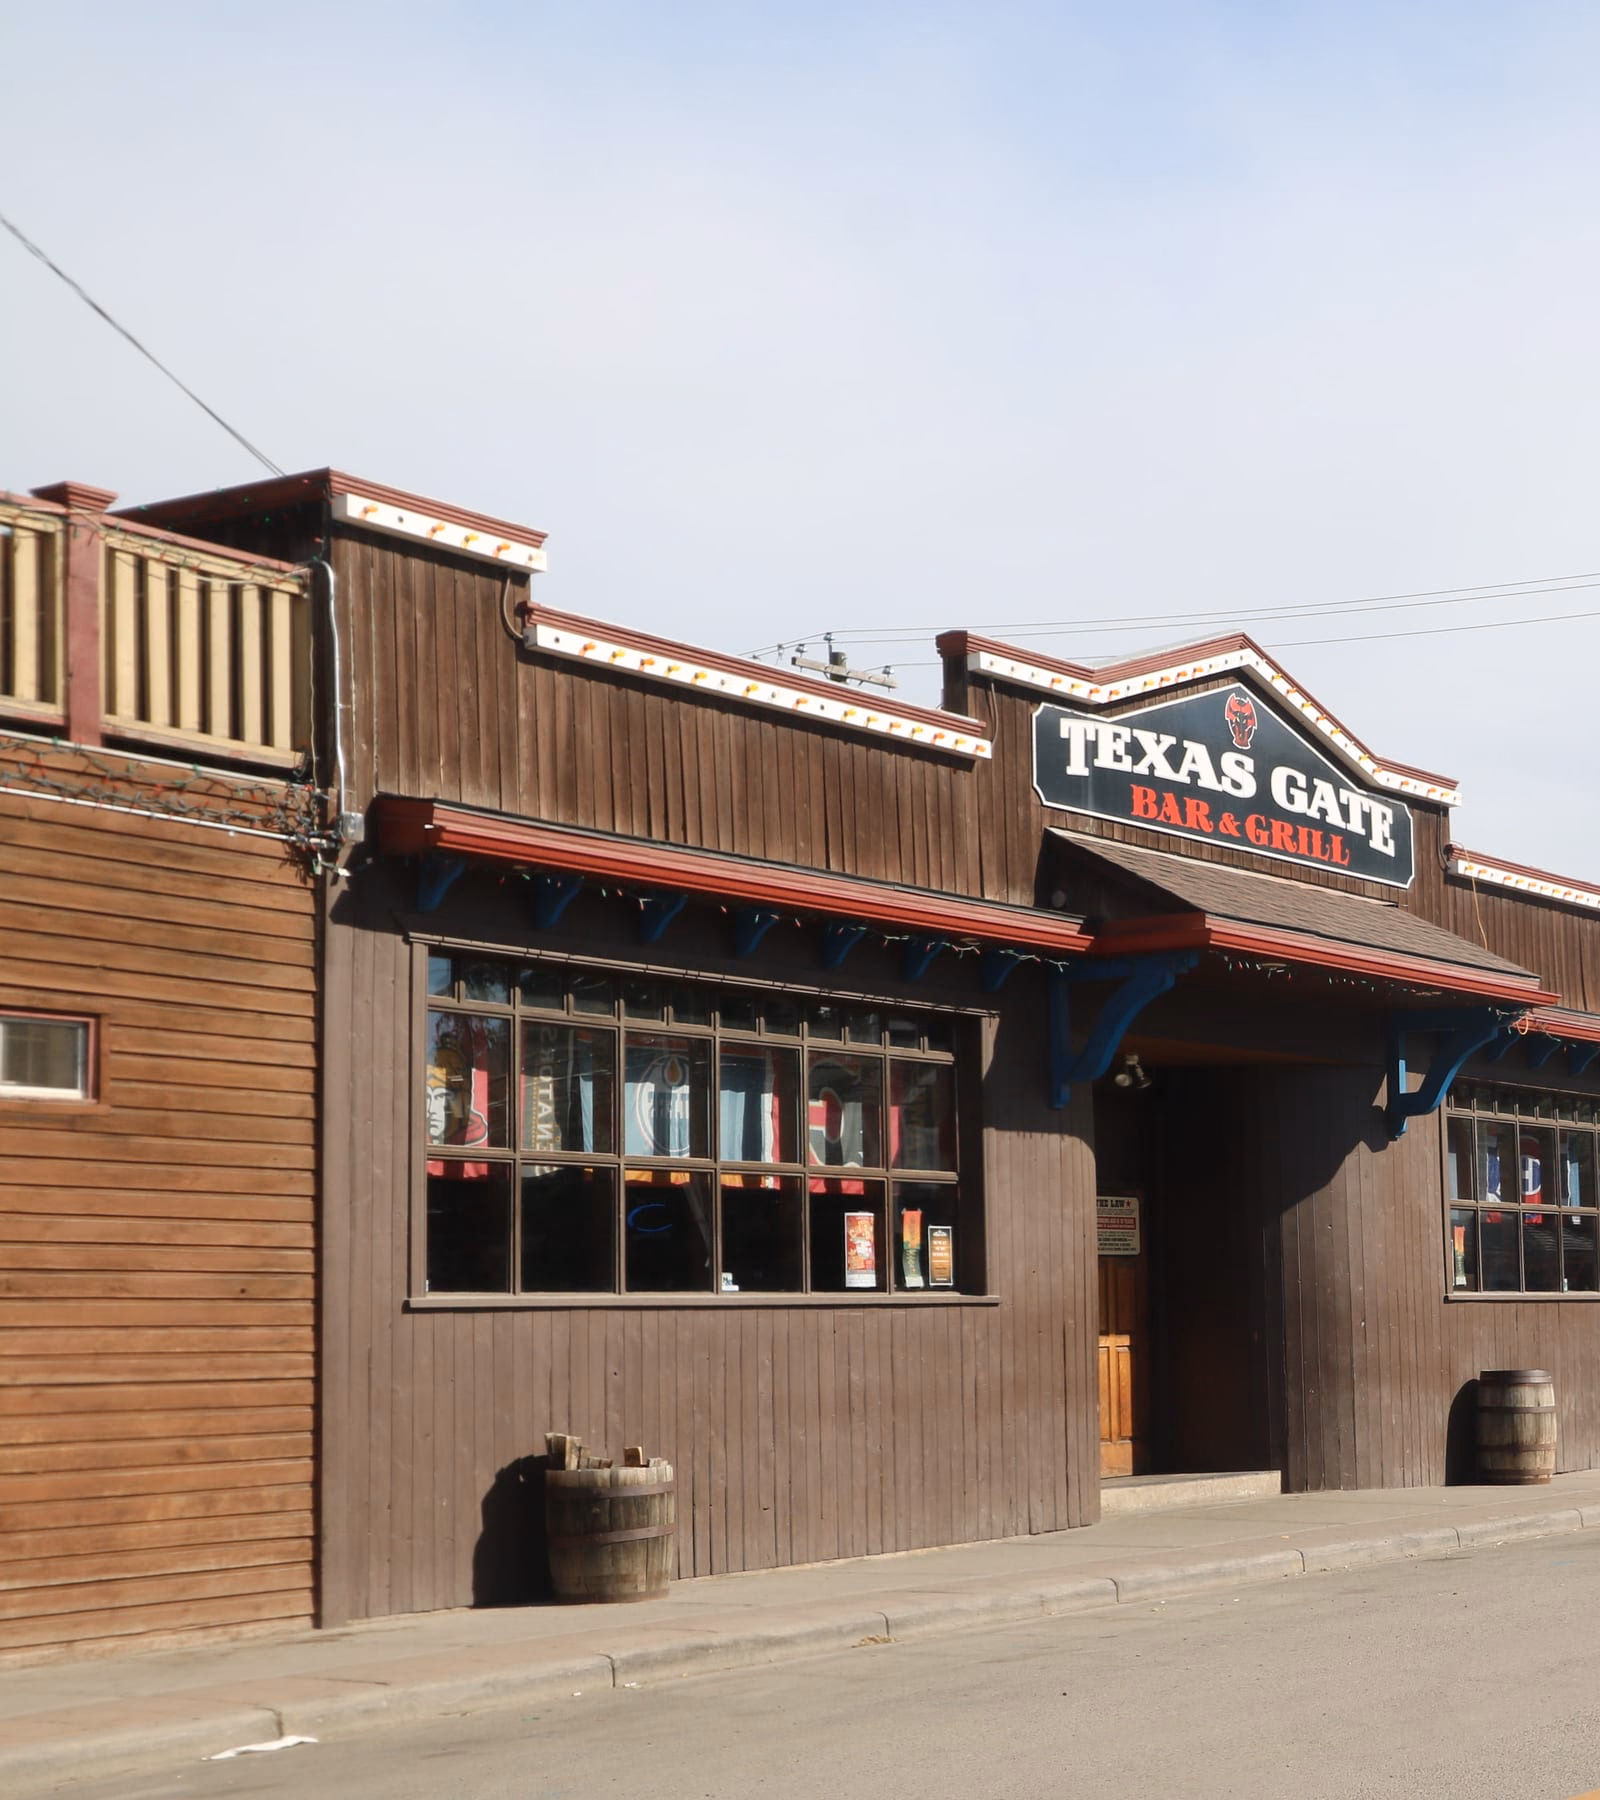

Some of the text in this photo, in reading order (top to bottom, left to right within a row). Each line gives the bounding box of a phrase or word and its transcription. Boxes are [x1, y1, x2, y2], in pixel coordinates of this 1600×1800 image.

[1060, 718, 1396, 857] TEXAS GATE
[1130, 784, 1351, 867] BAR & GRILL
